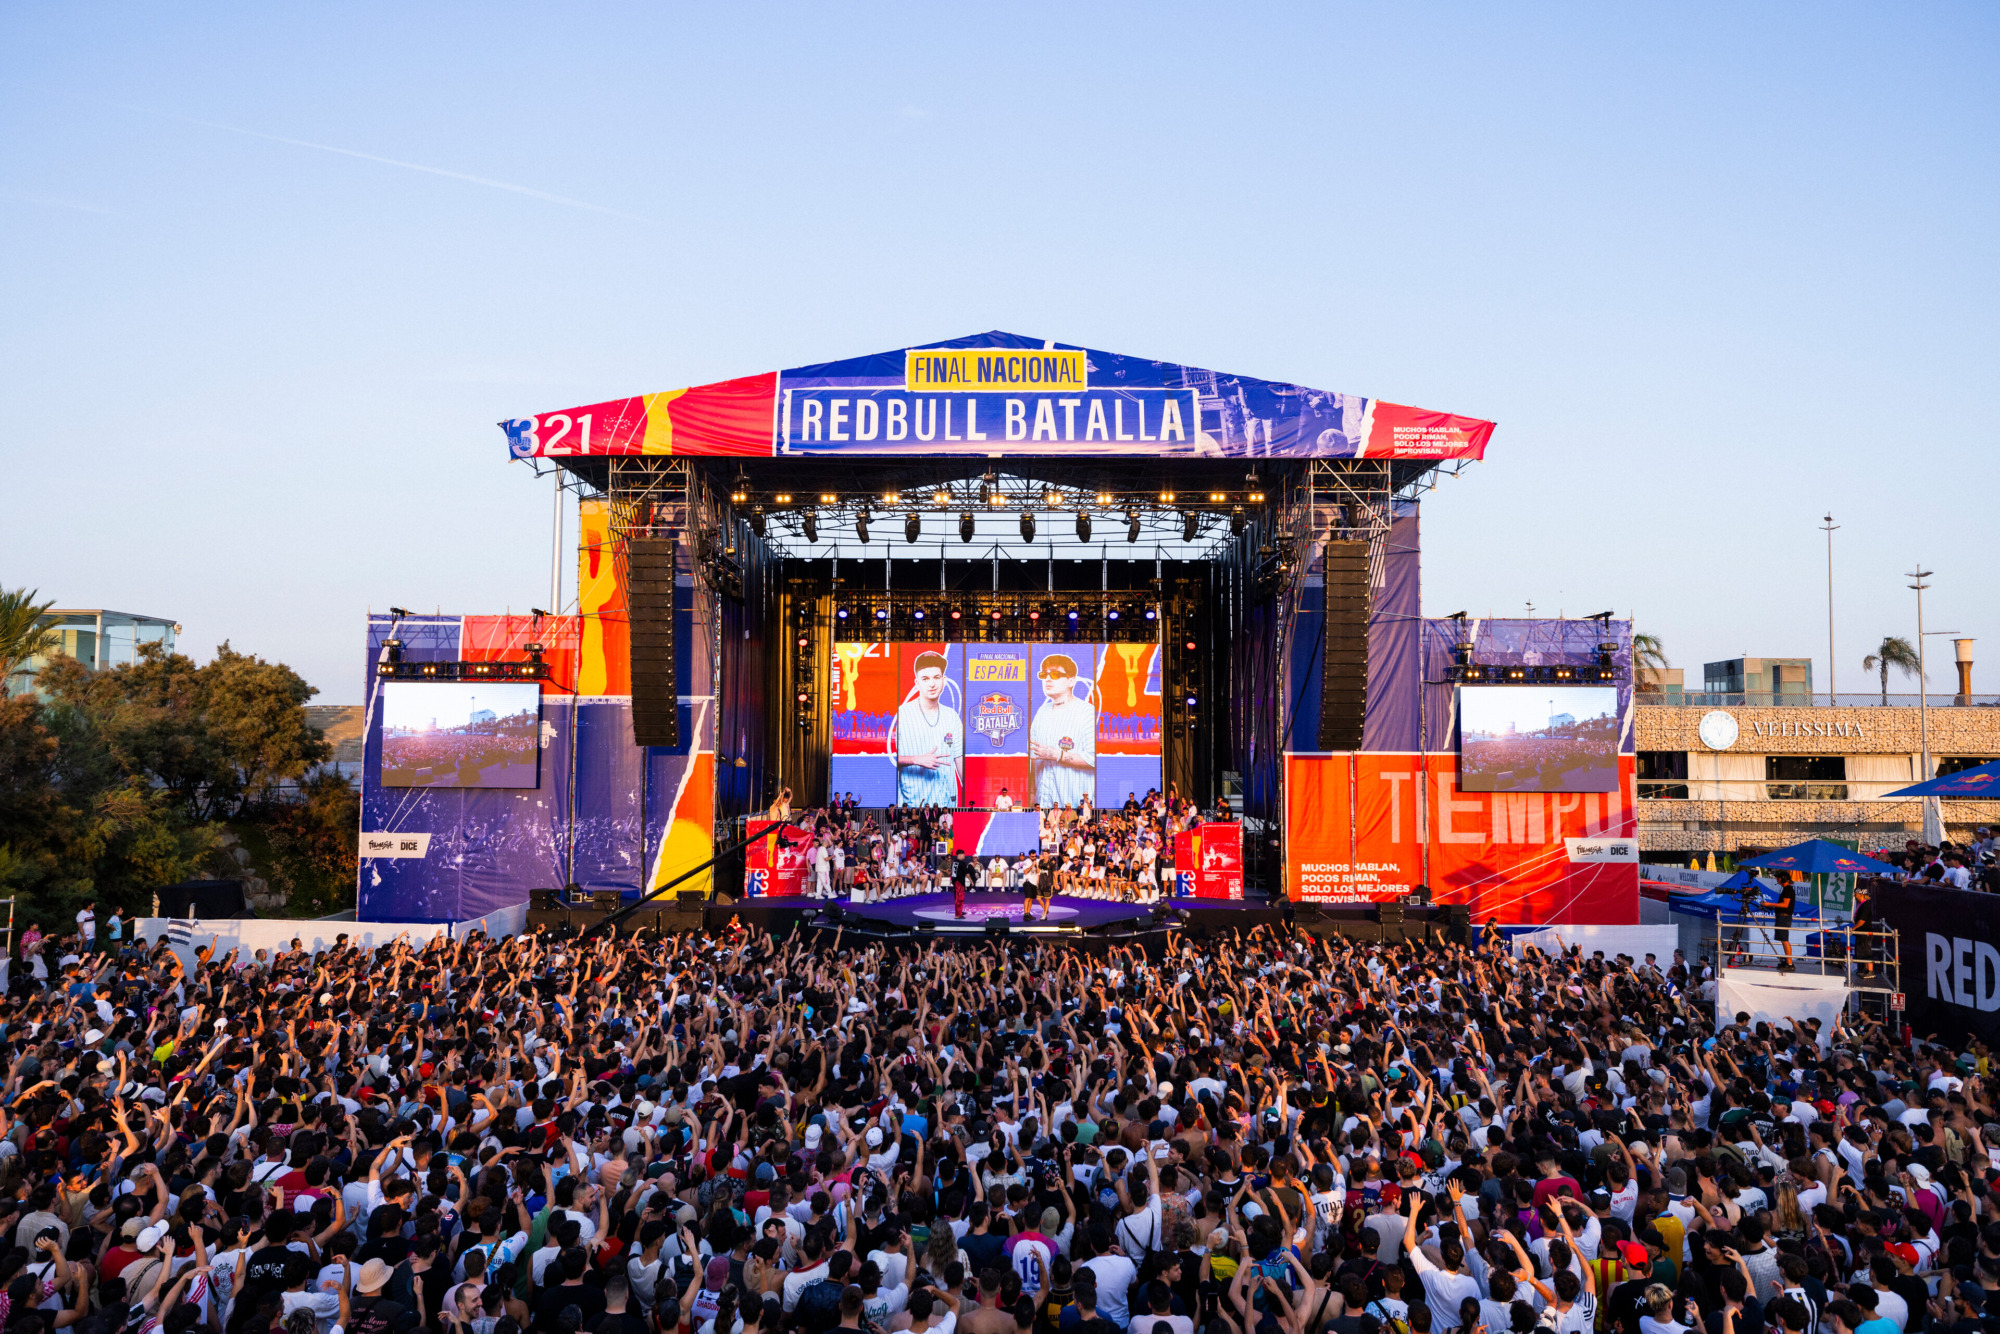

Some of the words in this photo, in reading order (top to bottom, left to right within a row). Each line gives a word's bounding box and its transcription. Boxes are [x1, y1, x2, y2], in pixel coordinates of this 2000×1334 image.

[915, 357, 971, 383] FINAL
[977, 356, 1082, 383] NACIONAL
[801, 398, 987, 442] REDBULL
[1006, 398, 1186, 442] BATALLA
[512, 413, 592, 457] 321
[974, 663, 1019, 680] ESPAÑA
[980, 705, 996, 714] Red
[997, 705, 1013, 714] Bull
[977, 714, 1018, 731] BATALLA
[1753, 721, 1865, 737] VELISSIMA
[1380, 772, 1637, 844] TIEMPO
[401, 842, 418, 850] DICE
[1610, 847, 1629, 855] DICE
[1301, 863, 1350, 872] MUCHOS
[1353, 863, 1400, 873] HABLAN,
[753, 869, 769, 897] 321
[1182, 871, 1196, 897] 321
[1301, 874, 1340, 883] POCOS
[1342, 873, 1381, 883] RIMAN,
[1679, 872, 1699, 883] WELCOME
[1301, 885, 1331, 893] SOLO
[1334, 885, 1354, 893] LOS
[1357, 884, 1410, 893] MEJORES
[1301, 895, 1373, 903] IMPROVISAN.
[1925, 932, 2000, 1012] RED
[1314, 1199, 1346, 1217] Tupa
